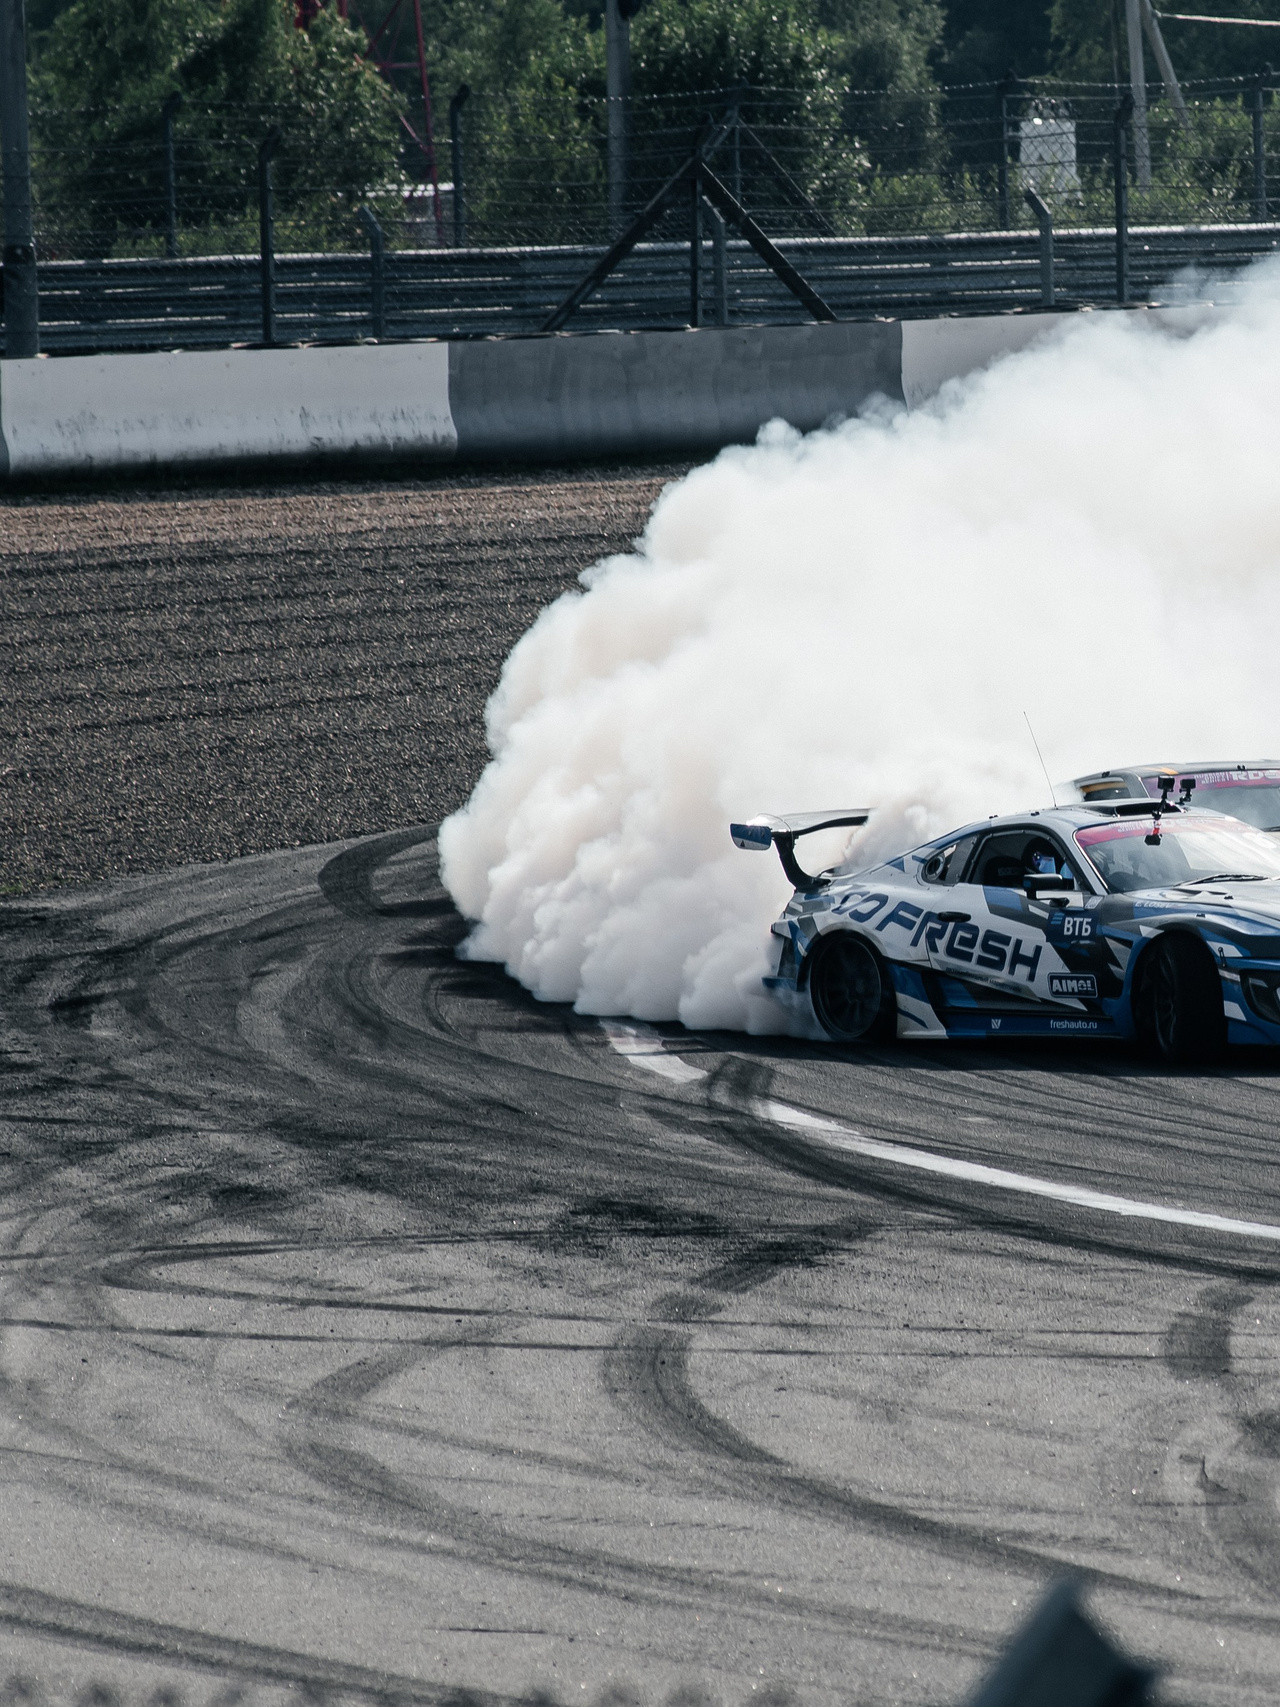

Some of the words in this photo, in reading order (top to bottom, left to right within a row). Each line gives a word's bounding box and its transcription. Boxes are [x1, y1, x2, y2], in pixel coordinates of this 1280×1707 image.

[1063, 917, 1092, 936] ВТБ
[1052, 979, 1095, 993] AIMOL
[1050, 1019, 1098, 1029] freshauto.ru
